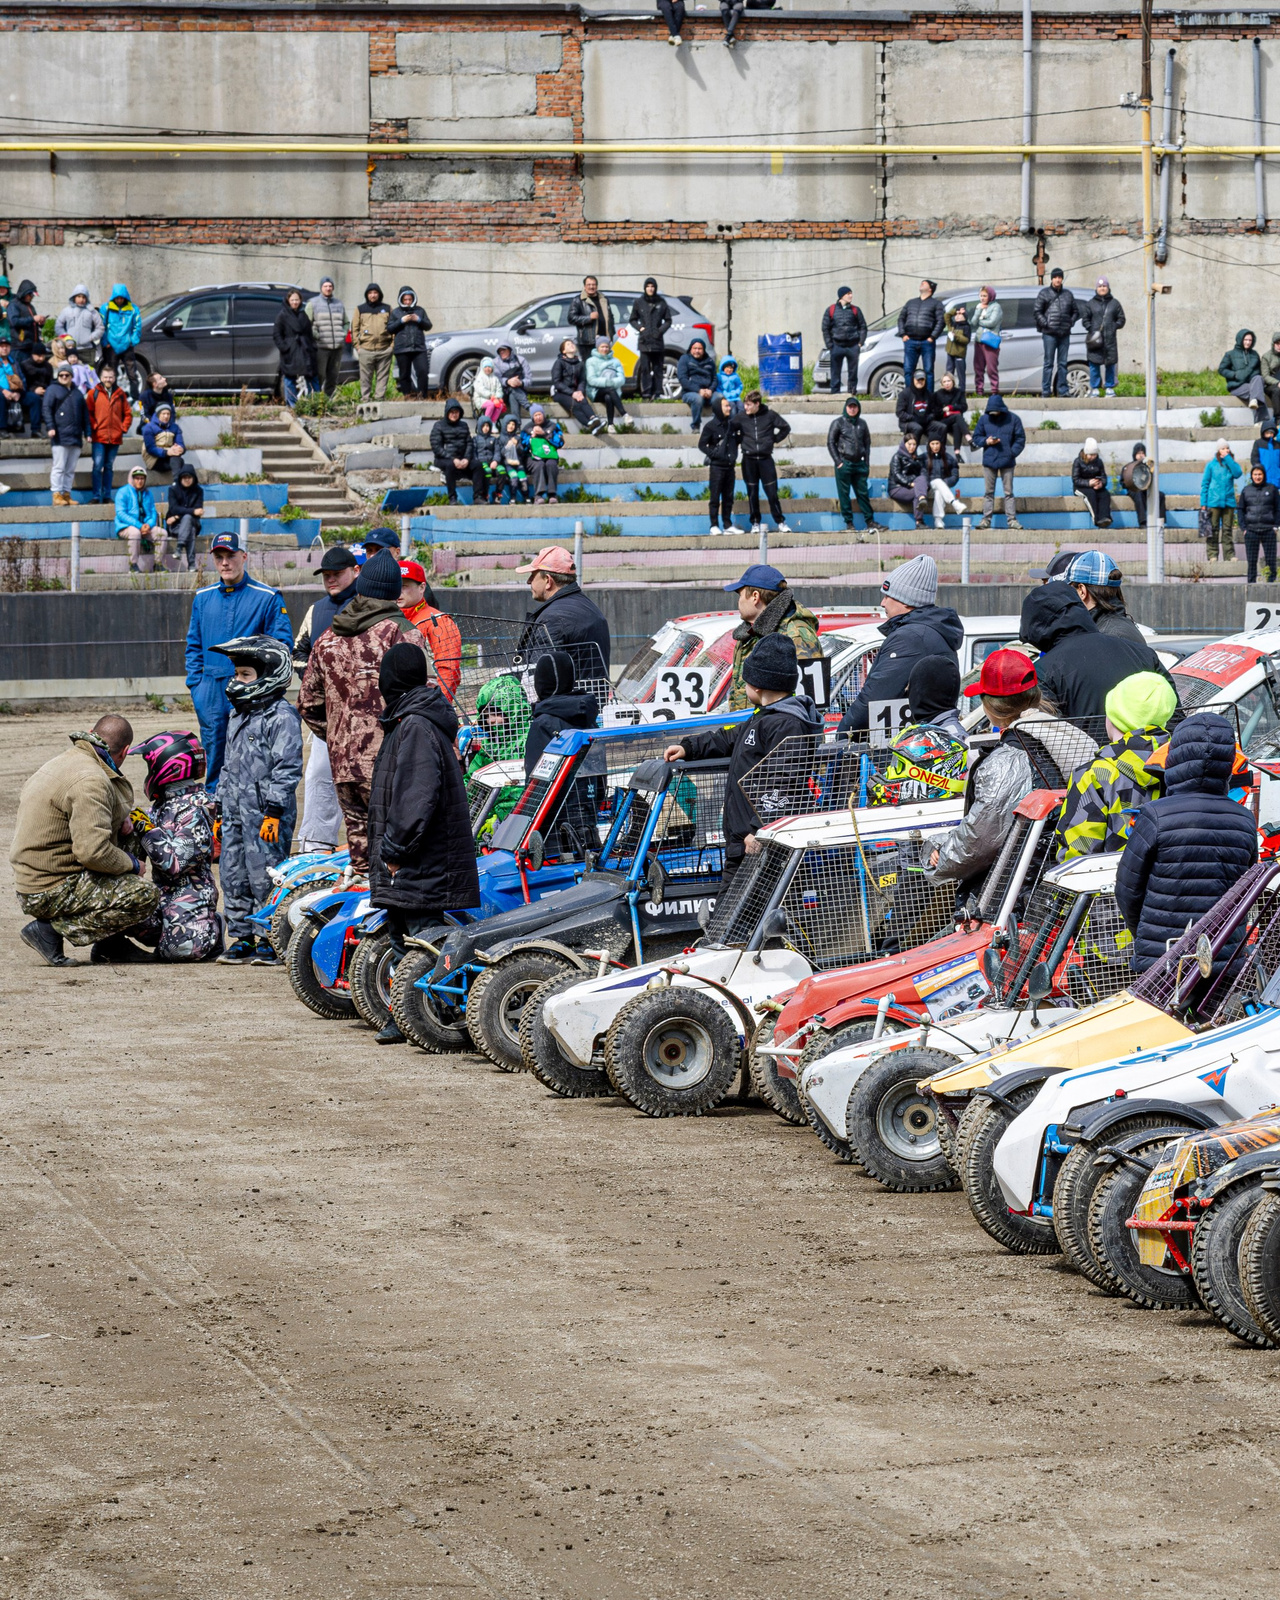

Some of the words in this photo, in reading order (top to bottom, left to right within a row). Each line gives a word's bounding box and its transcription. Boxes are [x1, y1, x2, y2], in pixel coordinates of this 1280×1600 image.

[515, 346, 537, 355] Такси
[661, 671, 704, 708] 33
[909, 766, 951, 790] ONEAL
